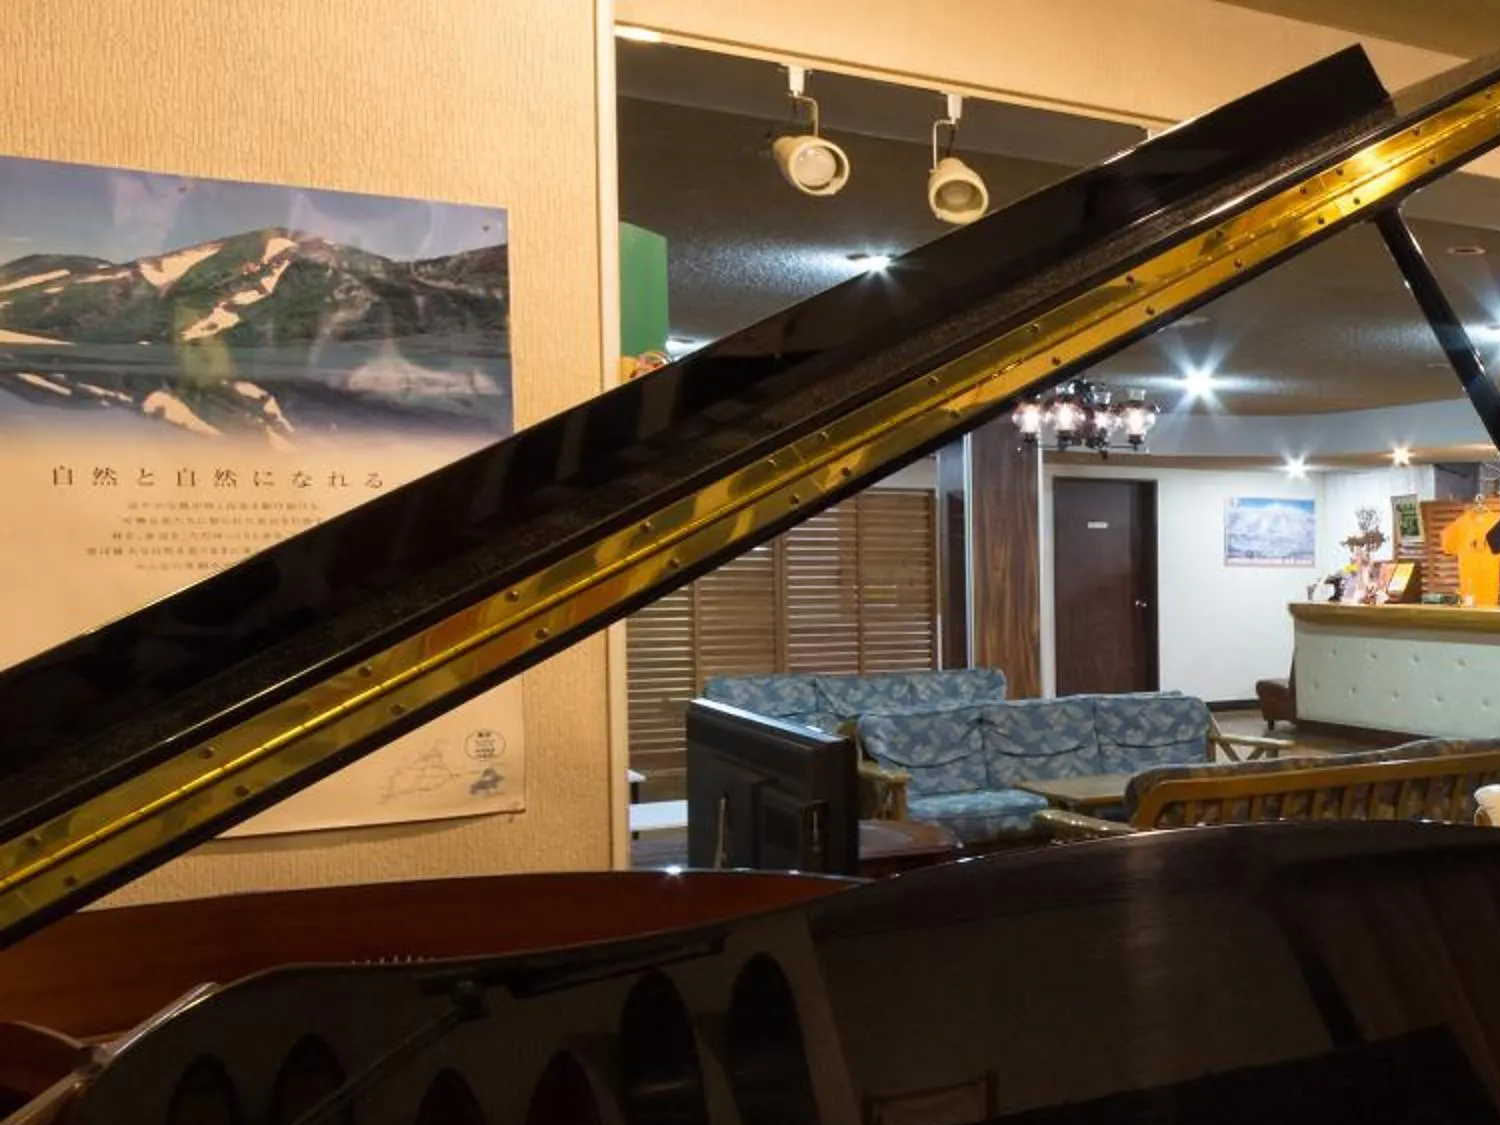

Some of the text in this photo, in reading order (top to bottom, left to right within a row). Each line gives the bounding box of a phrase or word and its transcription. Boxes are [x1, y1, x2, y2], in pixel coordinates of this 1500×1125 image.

[52, 465, 384, 489] 自然と自然になれる
